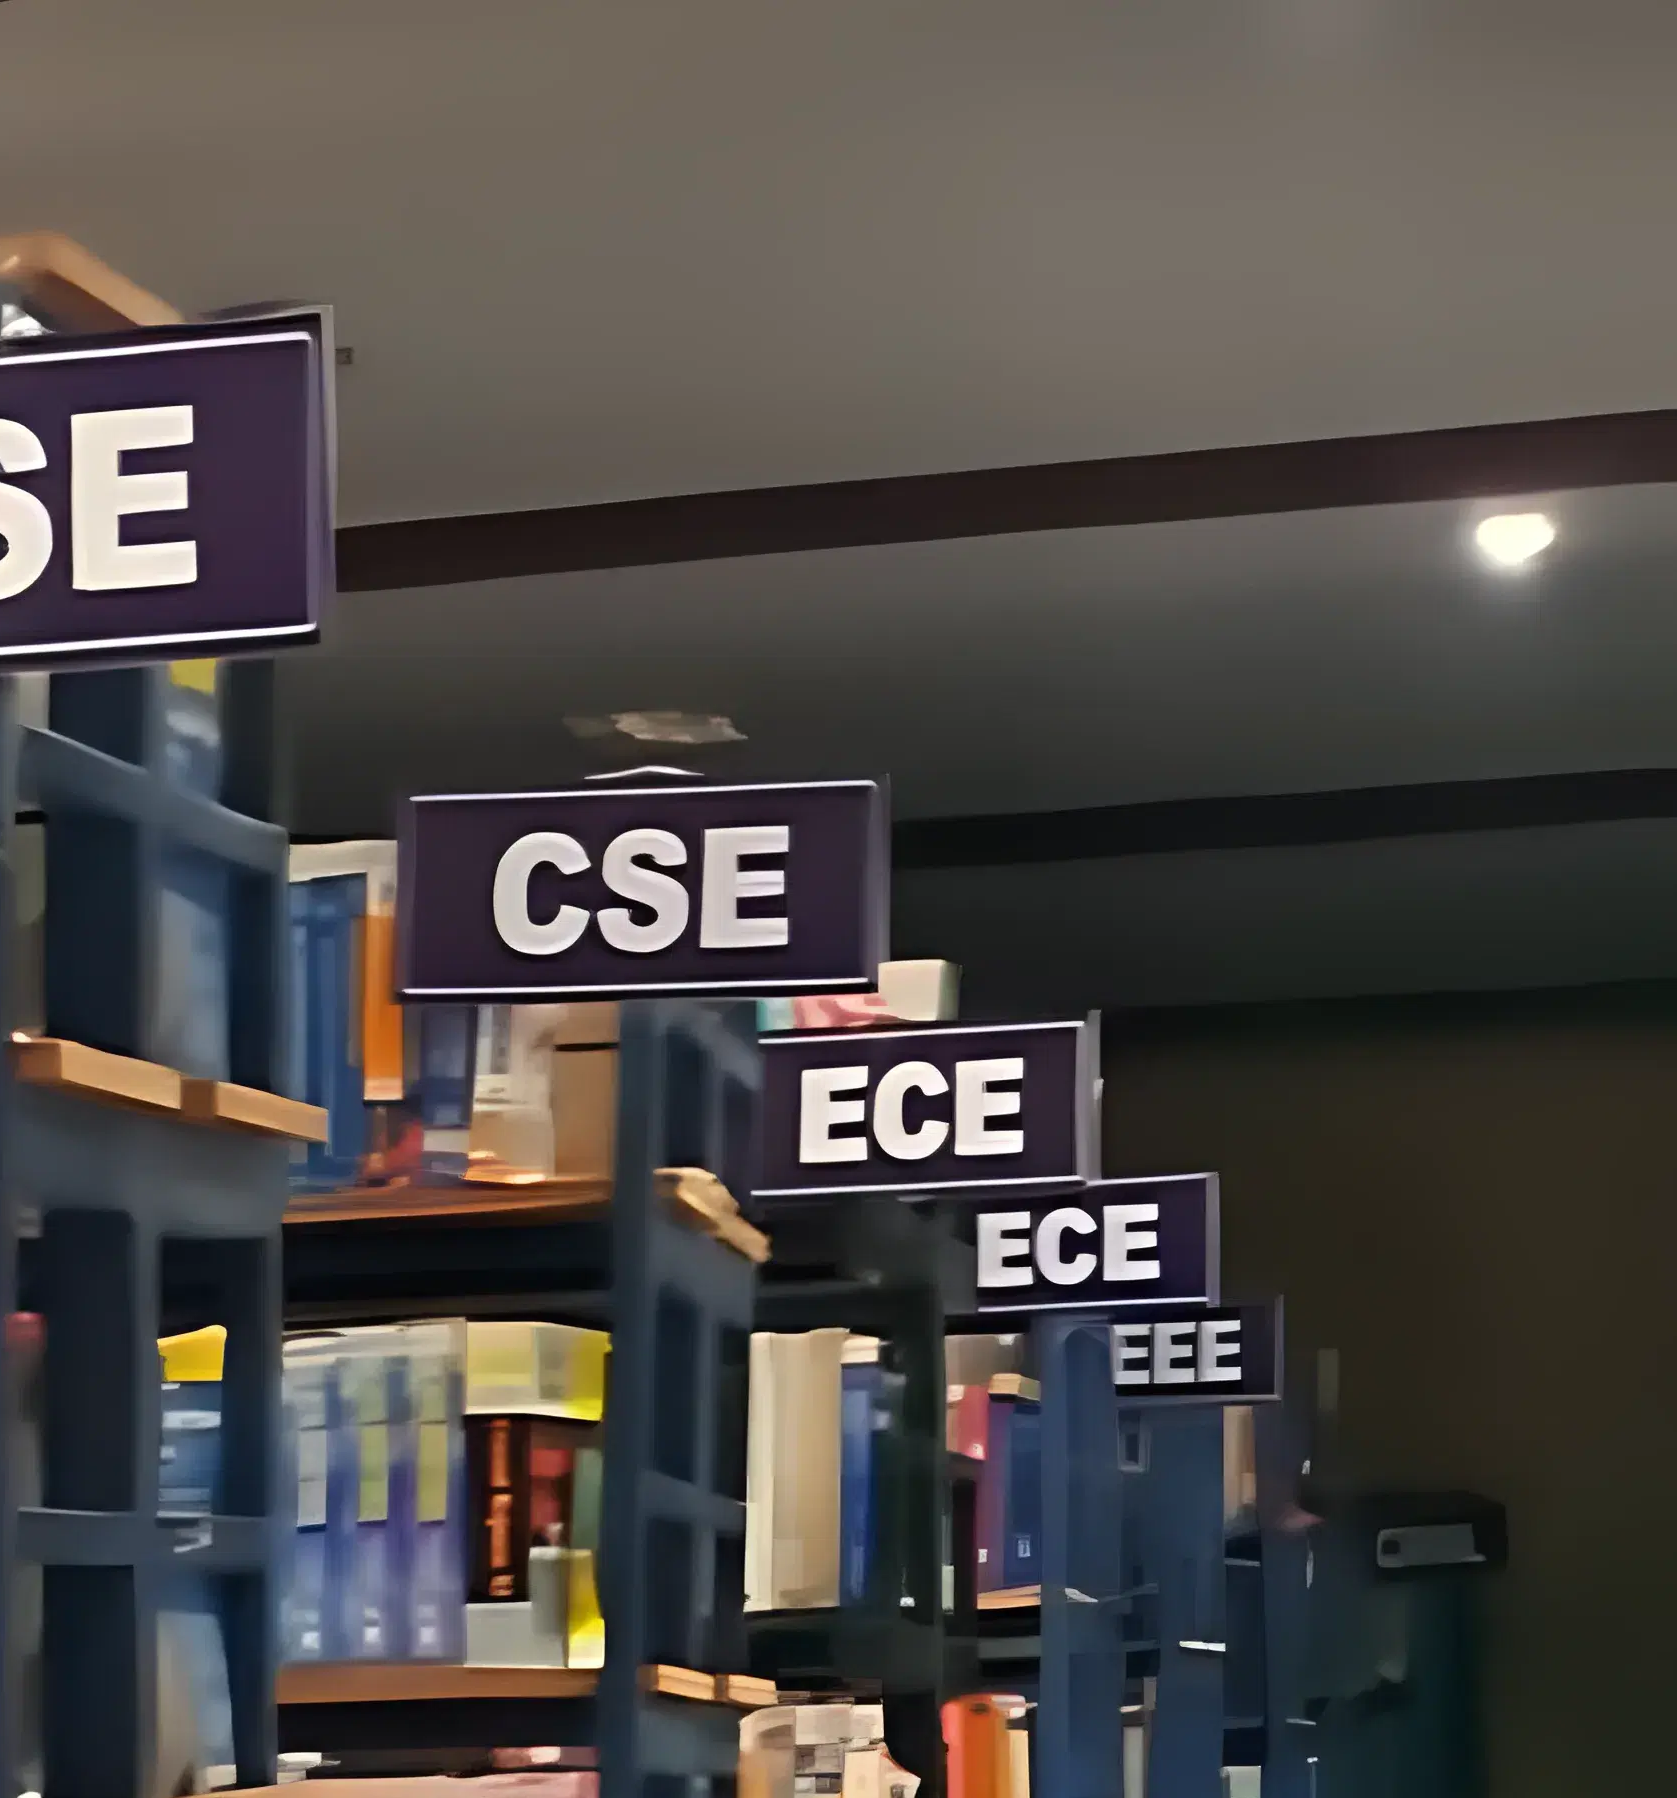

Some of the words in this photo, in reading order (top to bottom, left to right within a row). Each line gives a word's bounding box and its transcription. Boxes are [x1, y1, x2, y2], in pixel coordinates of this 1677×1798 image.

[492, 825, 791, 956] CSE
[798, 1056, 1025, 1164] ECE
[974, 1203, 1161, 1288] ECE
[1113, 1319, 1243, 1384] EEE
